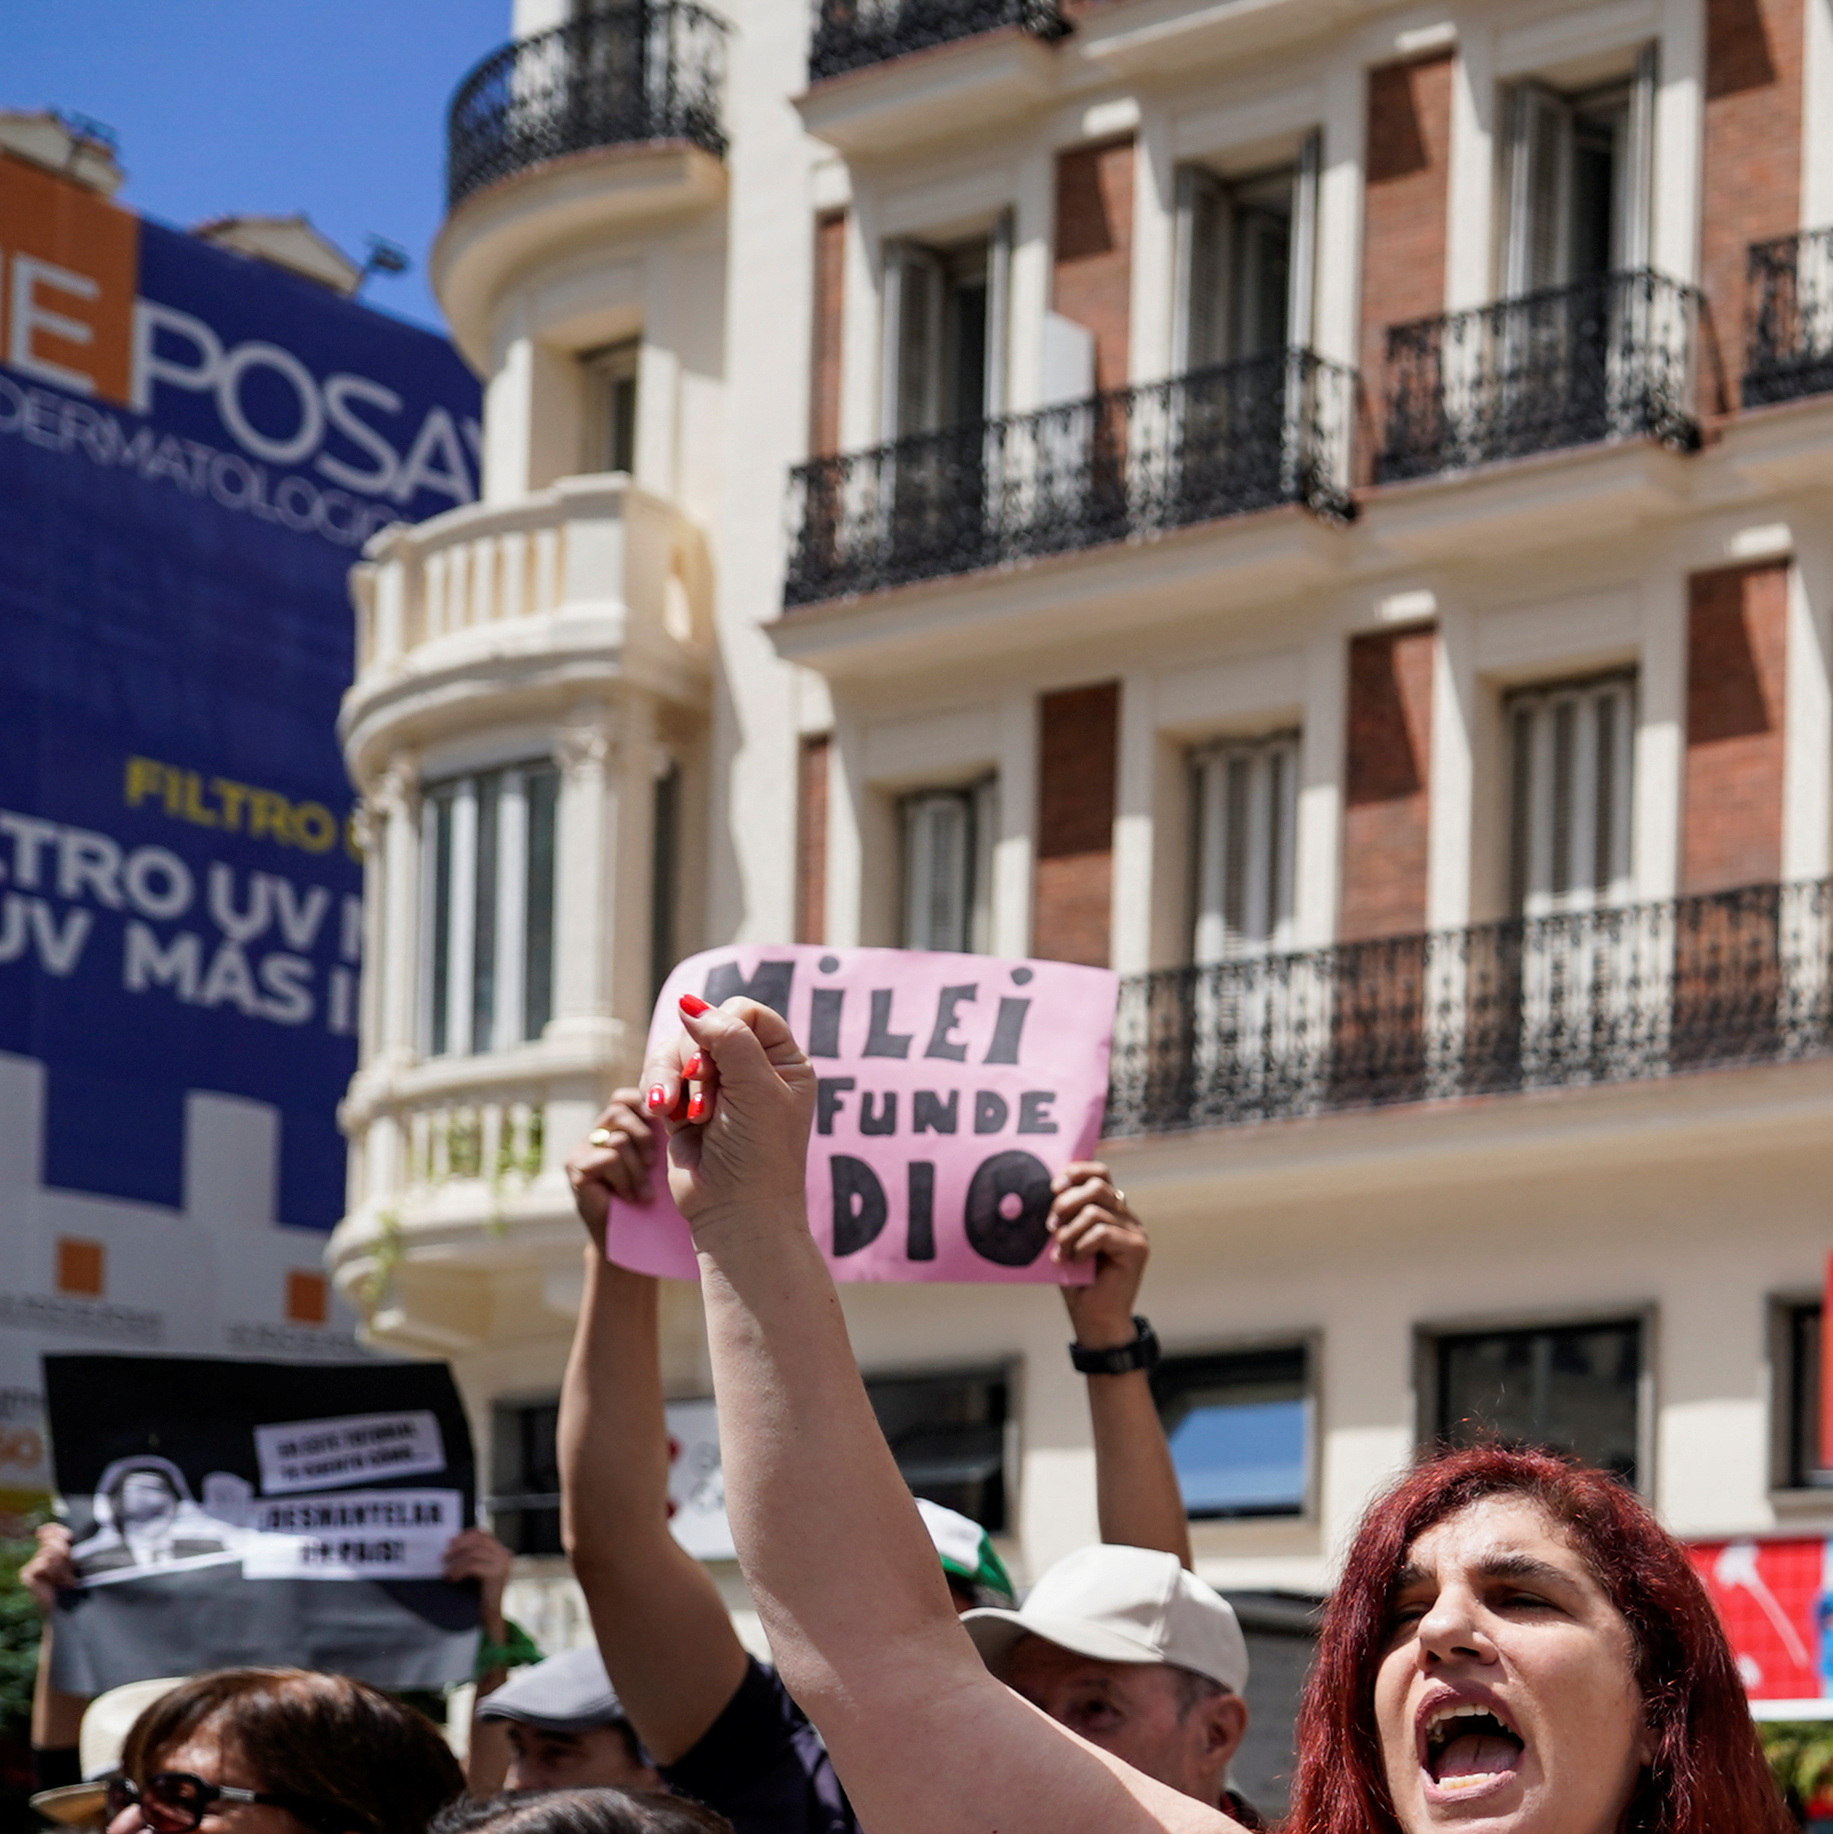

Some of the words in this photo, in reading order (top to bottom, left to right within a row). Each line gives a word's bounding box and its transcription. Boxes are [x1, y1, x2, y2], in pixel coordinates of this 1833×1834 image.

[0, 253, 100, 396] E
[130, 297, 484, 503] POSA
[125, 755, 338, 856] FILTRO
[0, 808, 196, 921] TRO
[207, 860, 333, 950] UV
